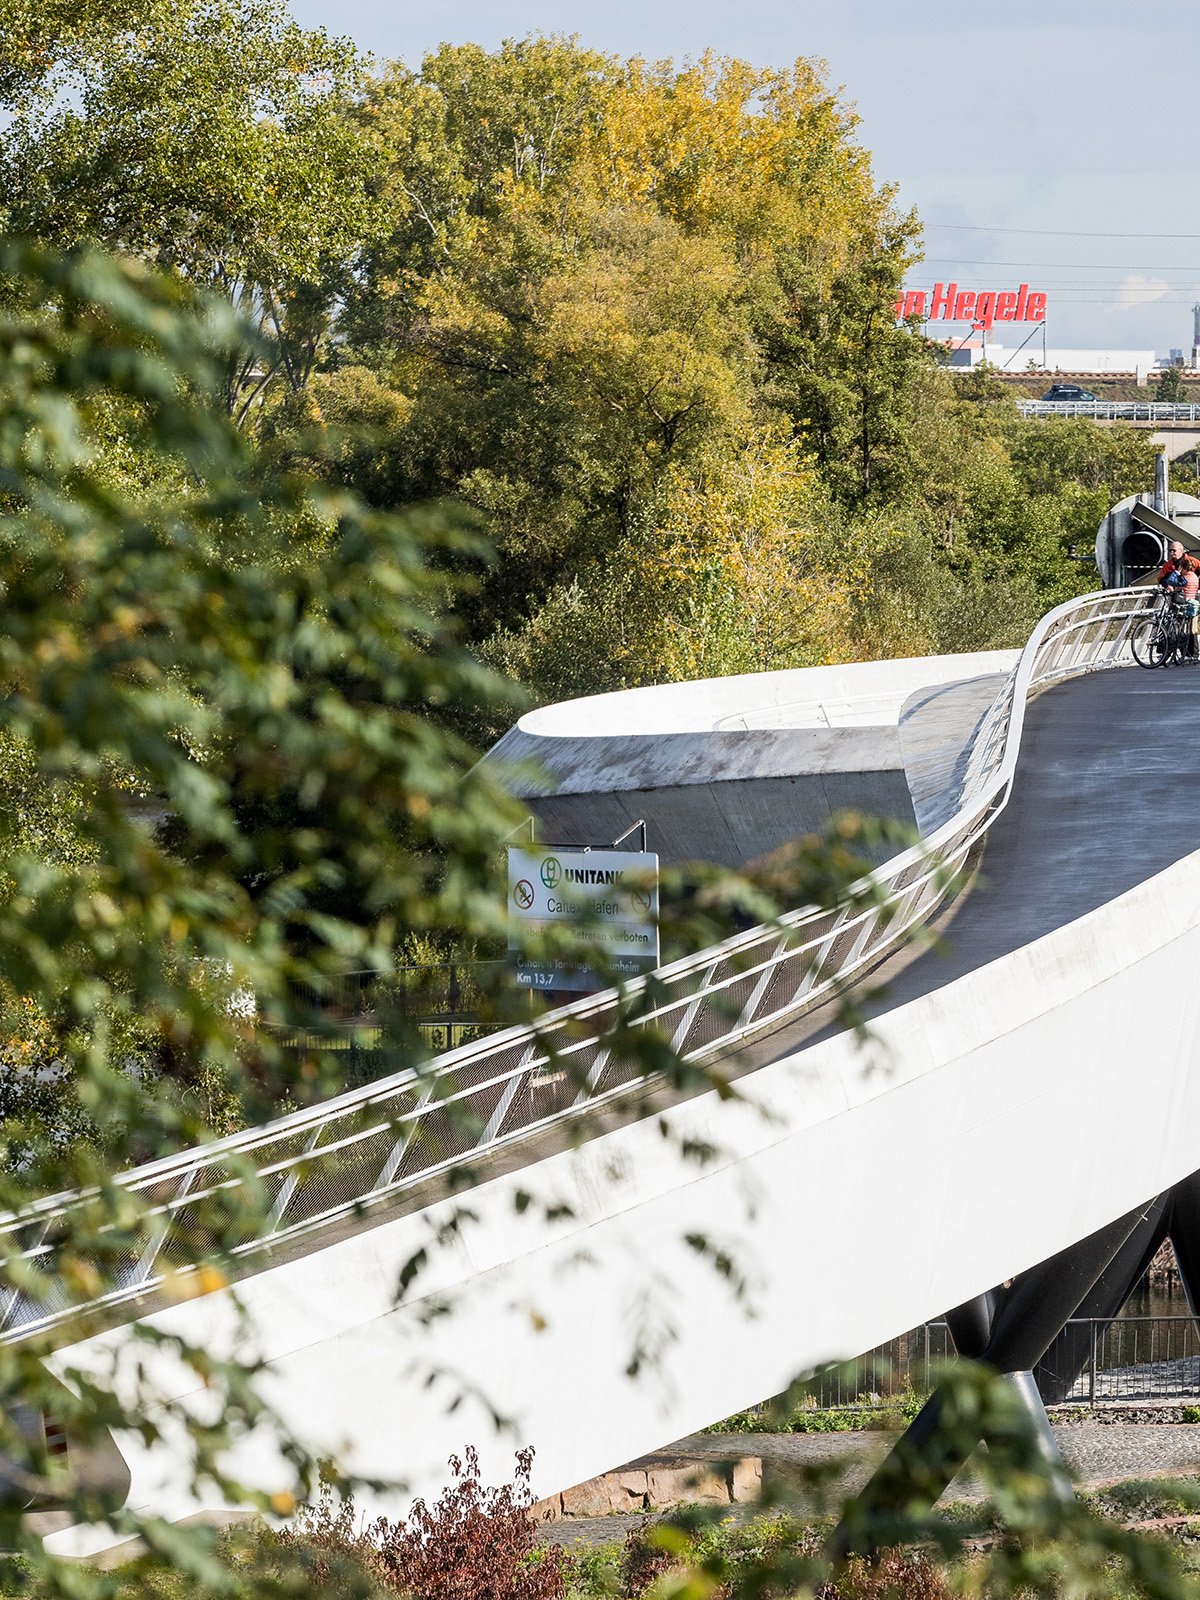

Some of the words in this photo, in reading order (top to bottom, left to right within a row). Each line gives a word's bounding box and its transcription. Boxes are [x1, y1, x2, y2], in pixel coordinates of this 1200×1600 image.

[930, 282, 1048, 331] Hegele
[516, 972, 531, 983] Km
[534, 972, 554, 986] 13,7
